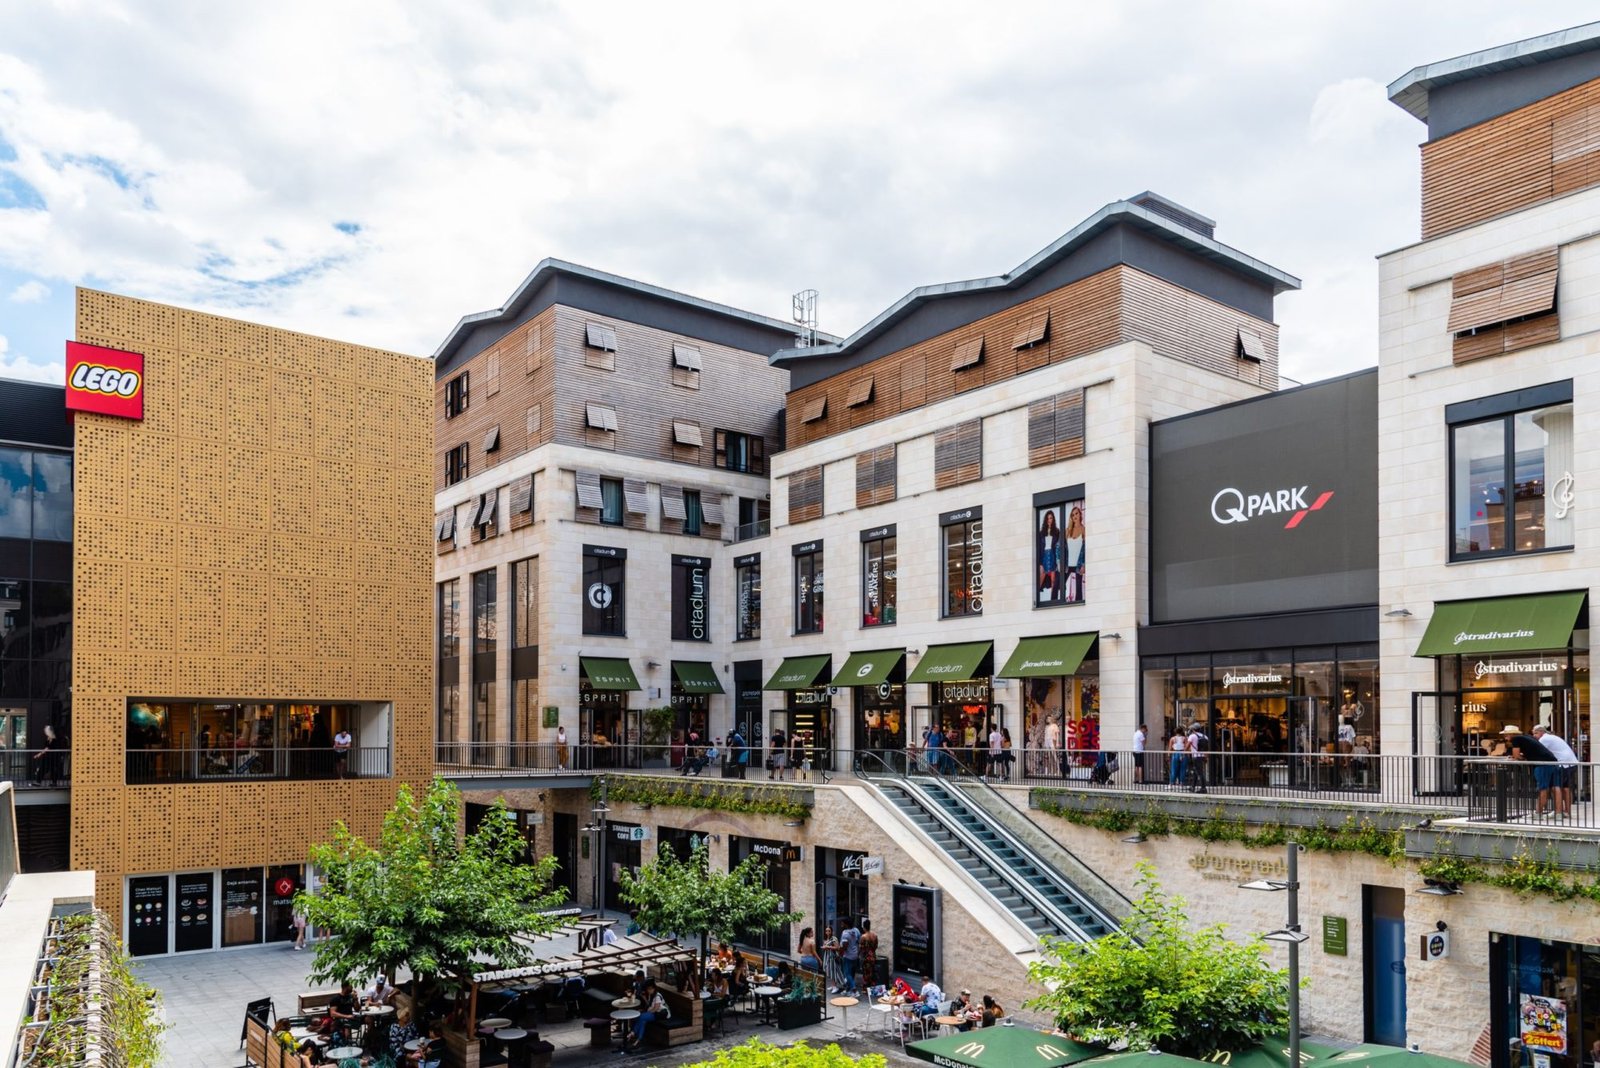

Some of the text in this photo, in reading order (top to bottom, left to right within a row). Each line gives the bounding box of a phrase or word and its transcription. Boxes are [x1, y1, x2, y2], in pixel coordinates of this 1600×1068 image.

[72, 364, 139, 397] LEGO
[968, 521, 983, 612] citadium
[690, 568, 704, 639] citadium
[1457, 630, 1534, 643] stradivarius
[927, 664, 963, 674] citadium
[1478, 661, 1557, 677] stradivarius
[1226, 673, 1282, 686] stradivarius
[944, 684, 988, 699] citadium
[1068, 720, 1100, 735] SOL
[1068, 737, 1100, 750] DES
[473, 966, 541, 982] STARBUCKS
